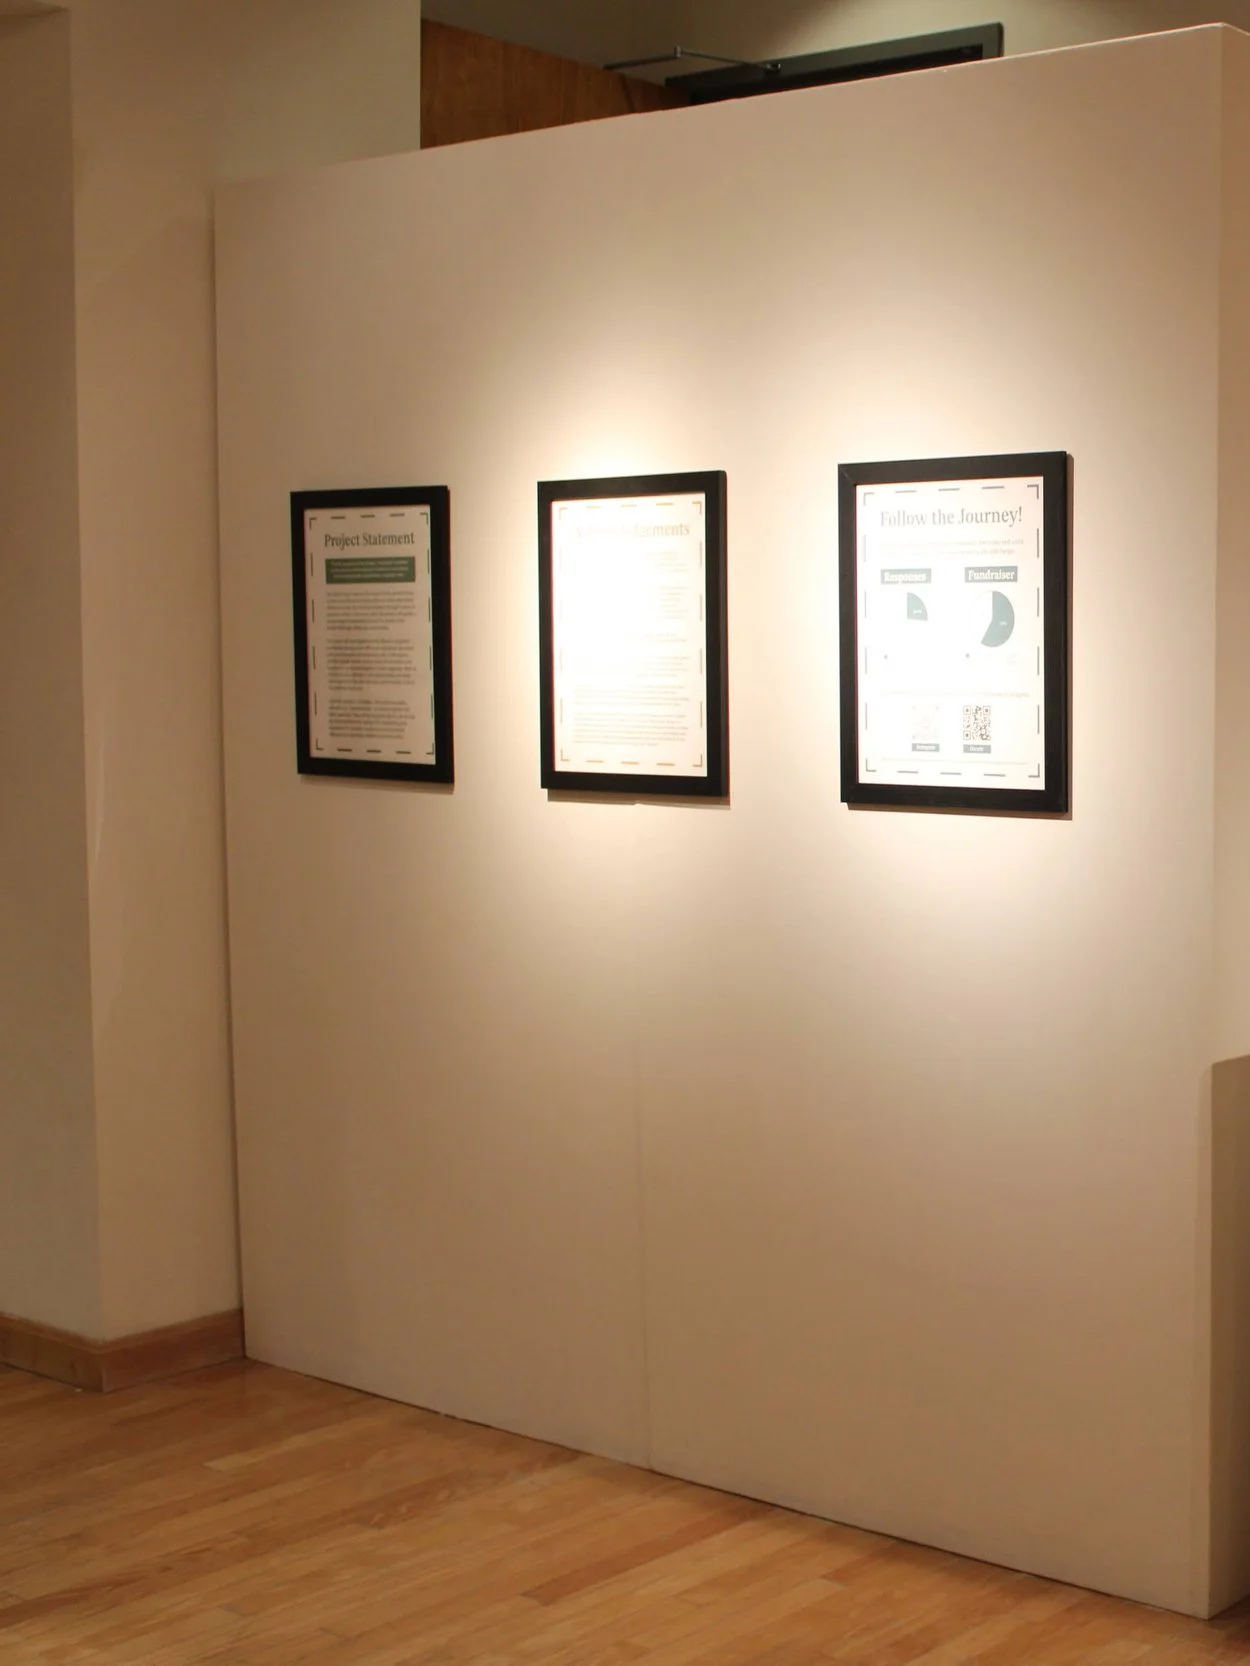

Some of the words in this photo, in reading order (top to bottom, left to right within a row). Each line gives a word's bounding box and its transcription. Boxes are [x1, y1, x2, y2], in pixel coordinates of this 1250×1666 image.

[880, 509, 927, 526] Follow
[932, 508, 955, 525] the
[957, 505, 1023, 528] Journey!
[324, 533, 360, 550] Project
[362, 532, 415, 547] Statement
[968, 569, 1016, 582] Fundraiser
